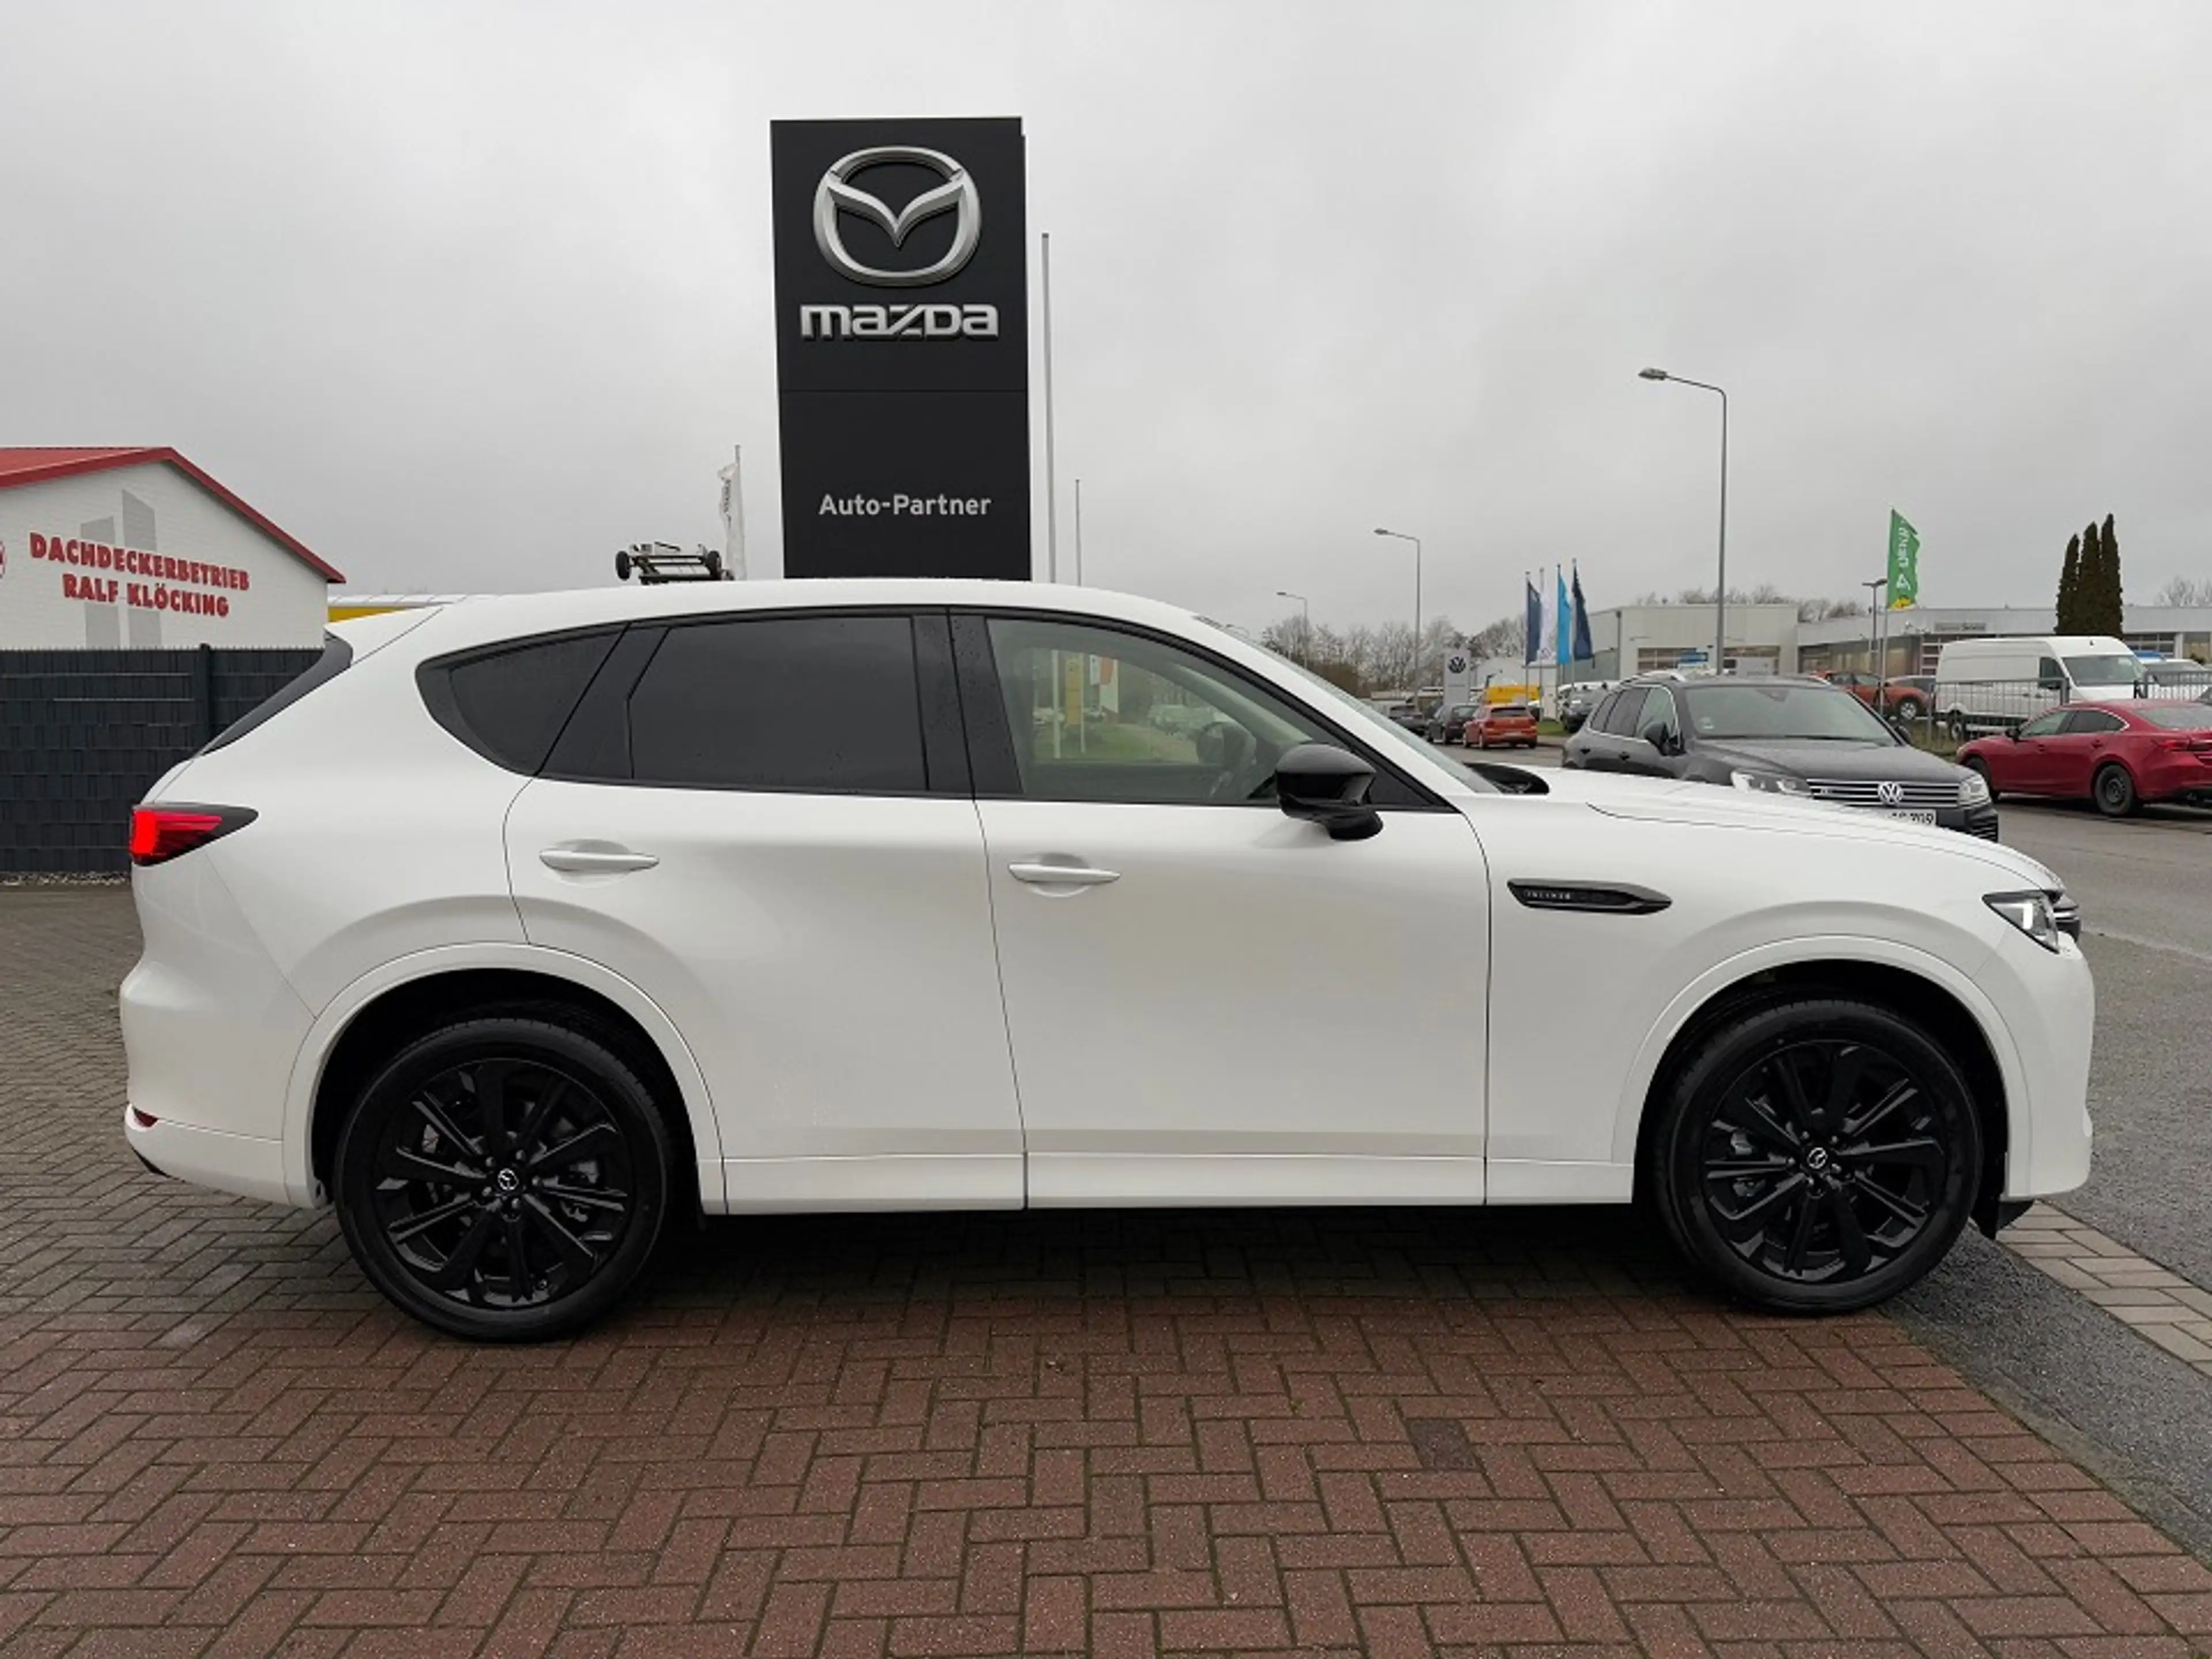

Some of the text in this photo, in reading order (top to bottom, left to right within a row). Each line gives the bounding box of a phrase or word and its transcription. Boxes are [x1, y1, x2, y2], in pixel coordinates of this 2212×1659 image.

[800, 304, 998, 337] mazda
[818, 493, 991, 515] Auto-Partner
[29, 532, 249, 591] DACHDECKERBETRIEB
[63, 573, 229, 617] RALF KLÖCKING
